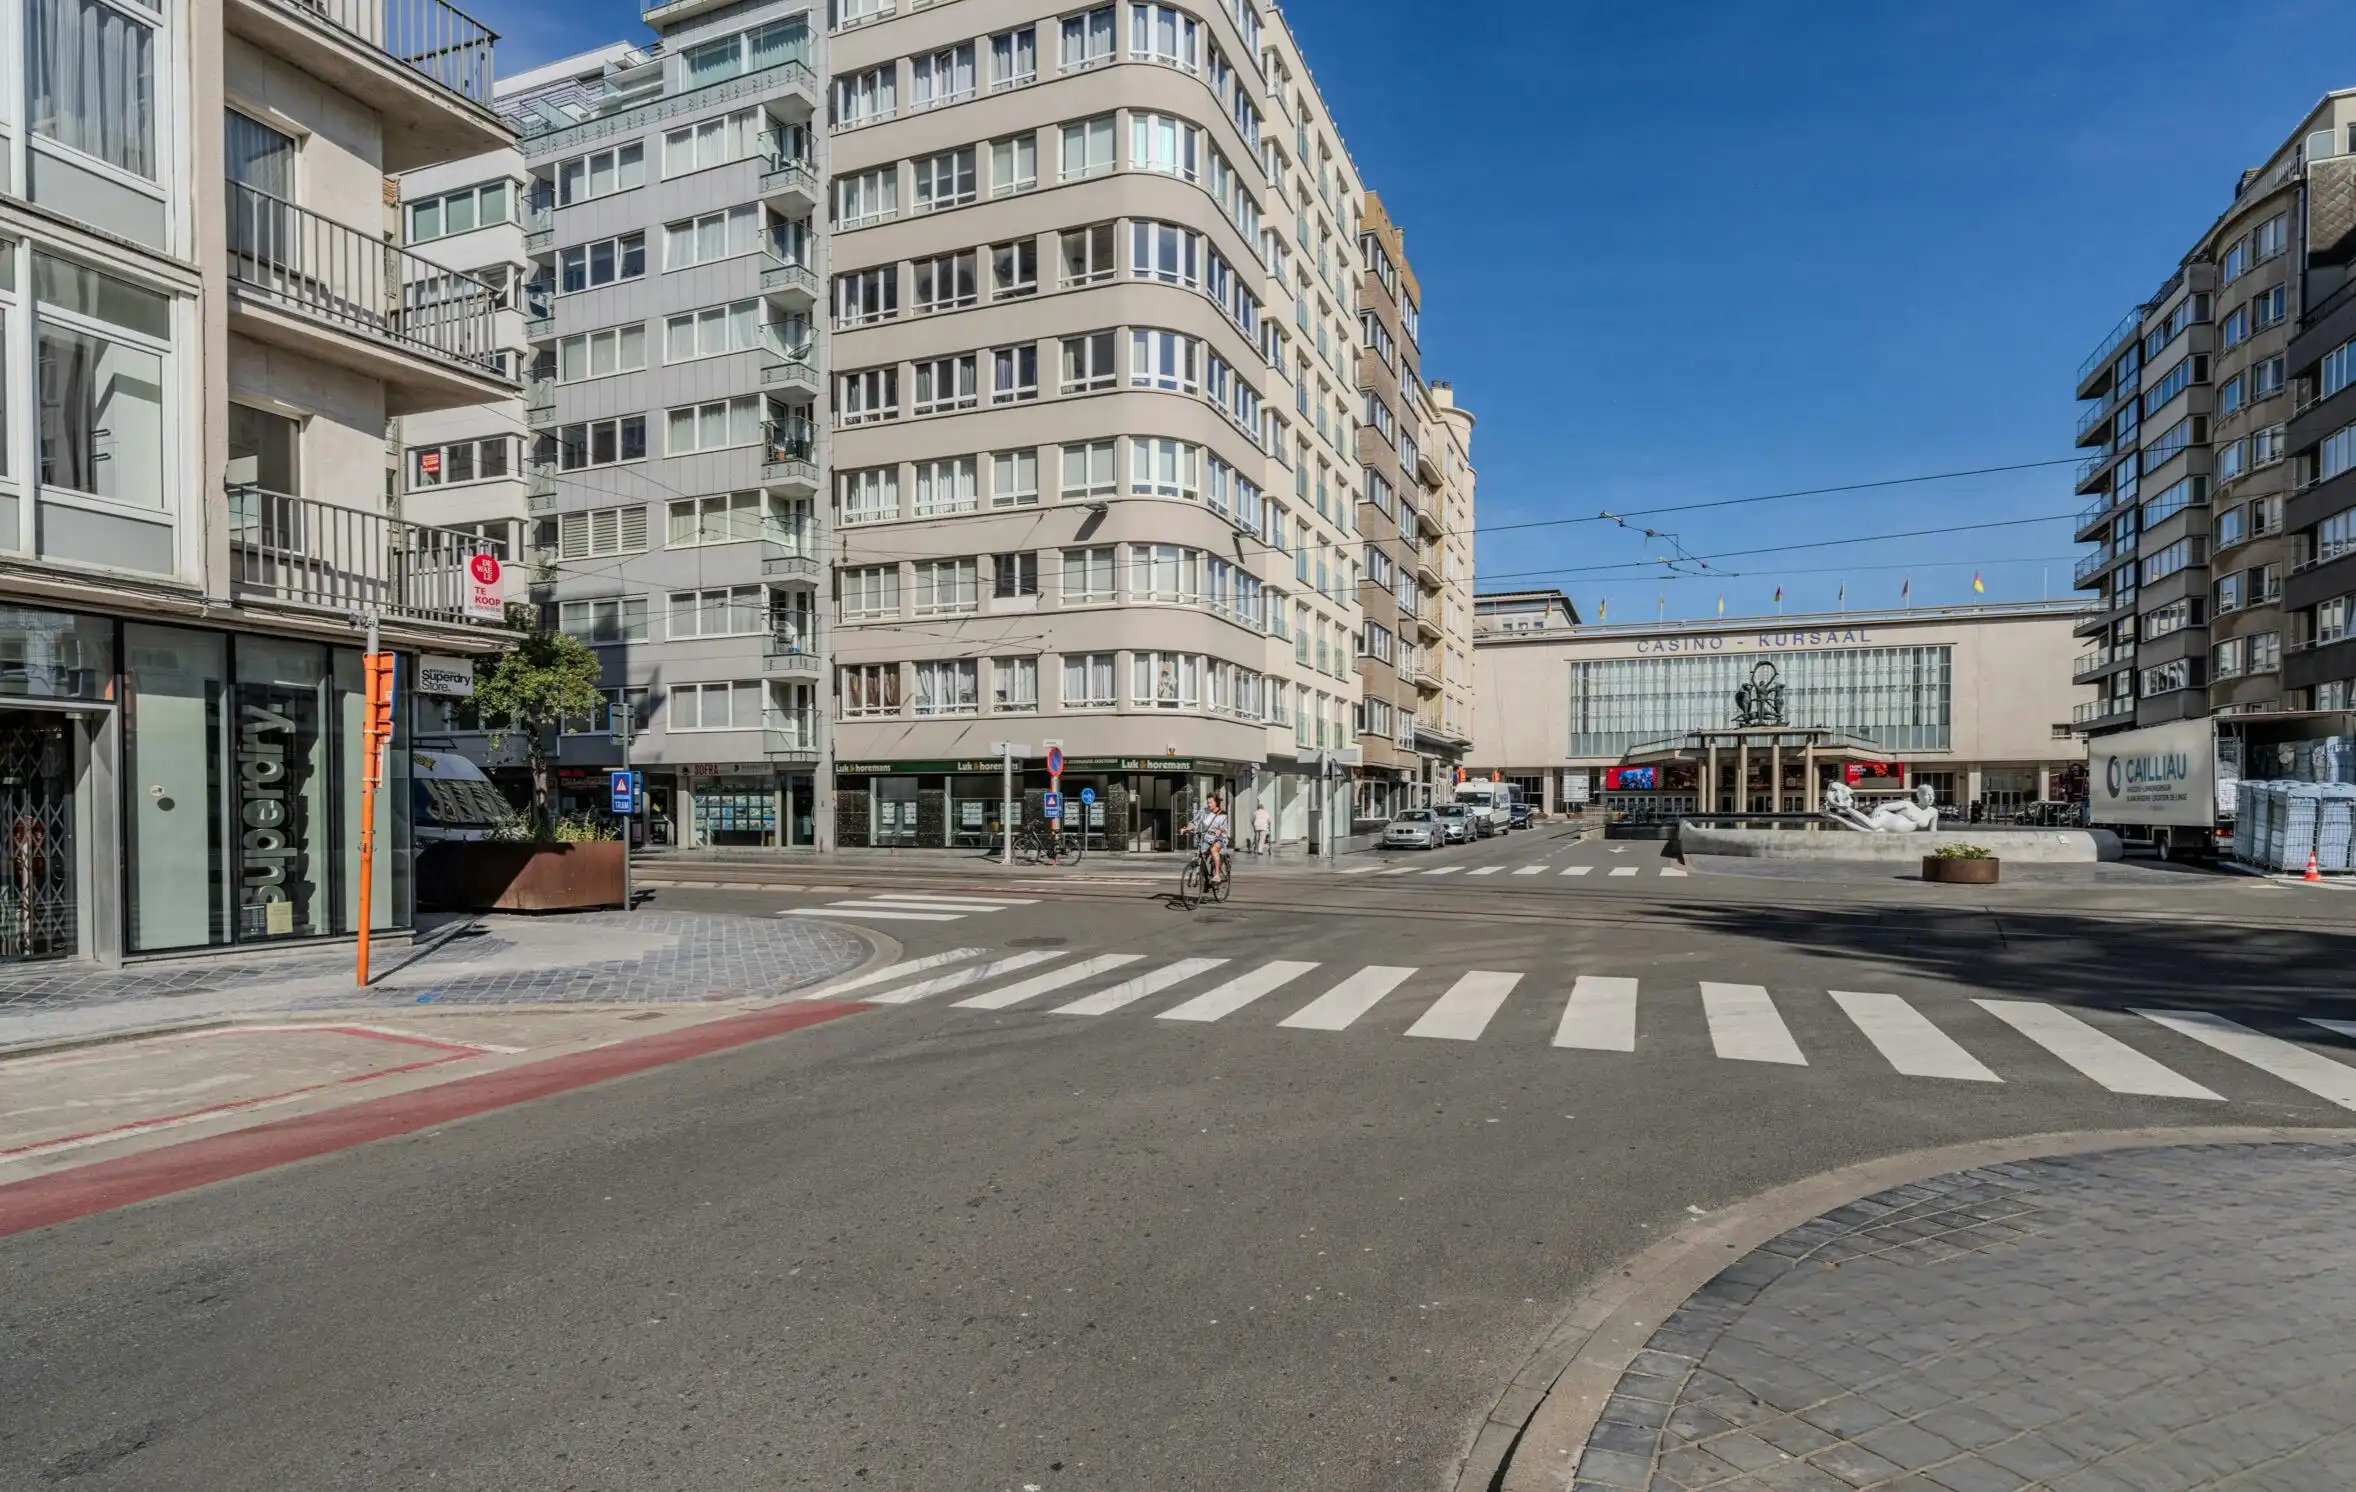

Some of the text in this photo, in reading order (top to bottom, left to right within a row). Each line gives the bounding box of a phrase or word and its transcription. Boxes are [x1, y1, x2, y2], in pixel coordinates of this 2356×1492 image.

[474, 586, 486, 595] TE
[475, 595, 501, 606] KOOP
[1637, 636, 1723, 653] CASINO
[1758, 629, 1872, 648] KURSAAL
[421, 669, 471, 686] Superdry
[2126, 752, 2187, 783] CAILLIAU
[614, 800, 630, 810] TRAM
